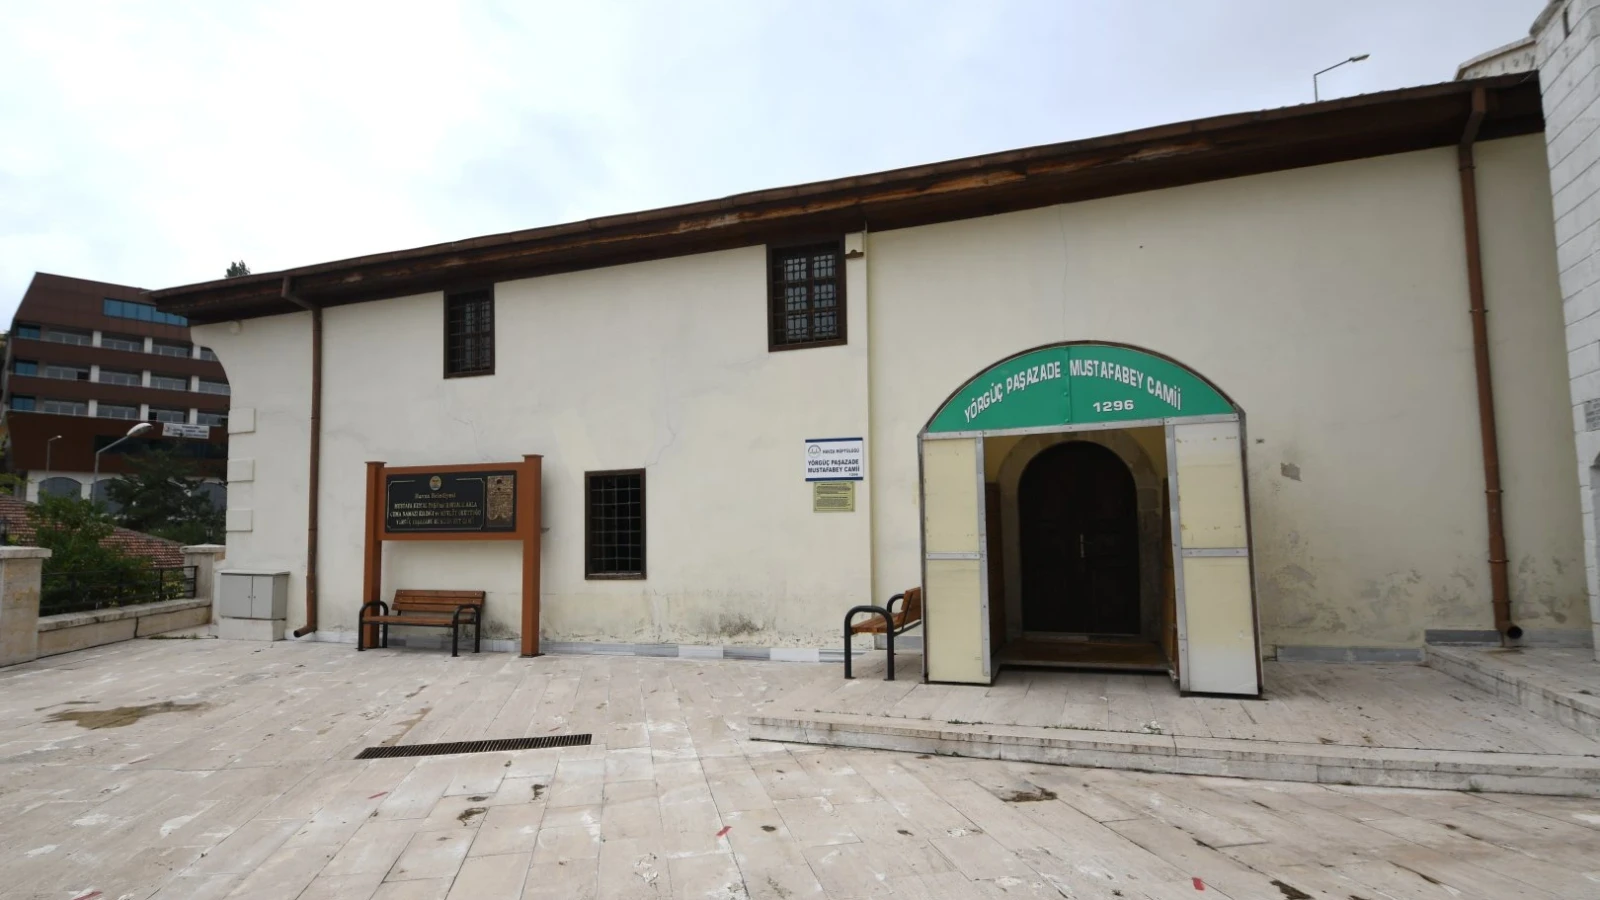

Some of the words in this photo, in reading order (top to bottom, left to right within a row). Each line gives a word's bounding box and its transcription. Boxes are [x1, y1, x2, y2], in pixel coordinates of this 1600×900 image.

[963, 382, 1003, 423] YÖRGÜÇ
[1005, 360, 1061, 395] PAŞAZADE
[1069, 359, 1144, 390] MUSTAFABEY
[1146, 375, 1183, 411] CAMİİ
[1092, 399, 1135, 414] 1296
[831, 458, 859, 466] PAŞAZADE
